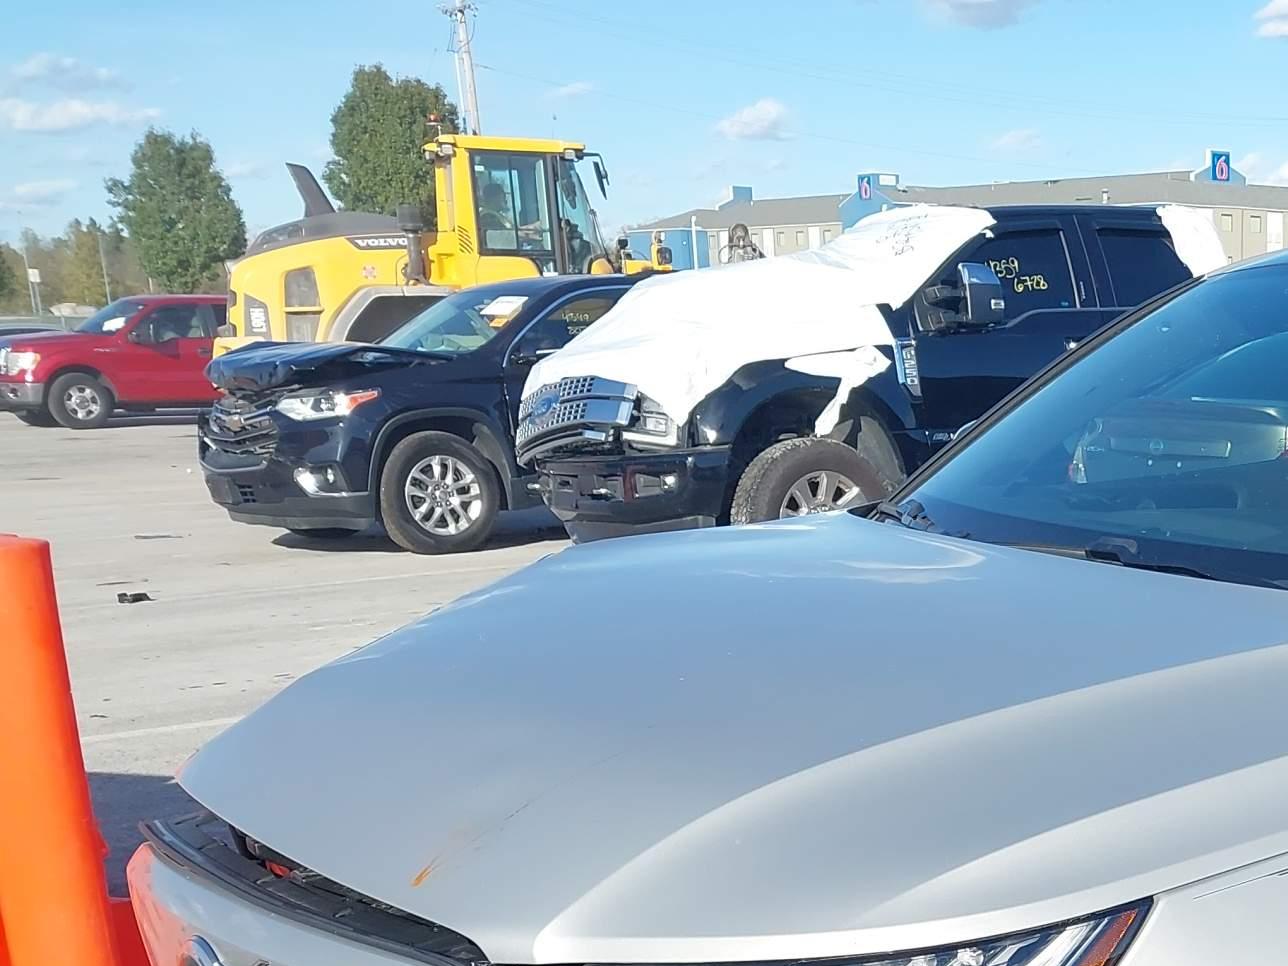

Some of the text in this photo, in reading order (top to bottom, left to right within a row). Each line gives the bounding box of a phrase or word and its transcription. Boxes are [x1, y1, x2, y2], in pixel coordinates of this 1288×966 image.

[1215, 155, 1229, 180] 6
[860, 177, 871, 200] 6
[354, 237, 408, 248] VOLVO
[1013, 274, 1049, 293] 6728
